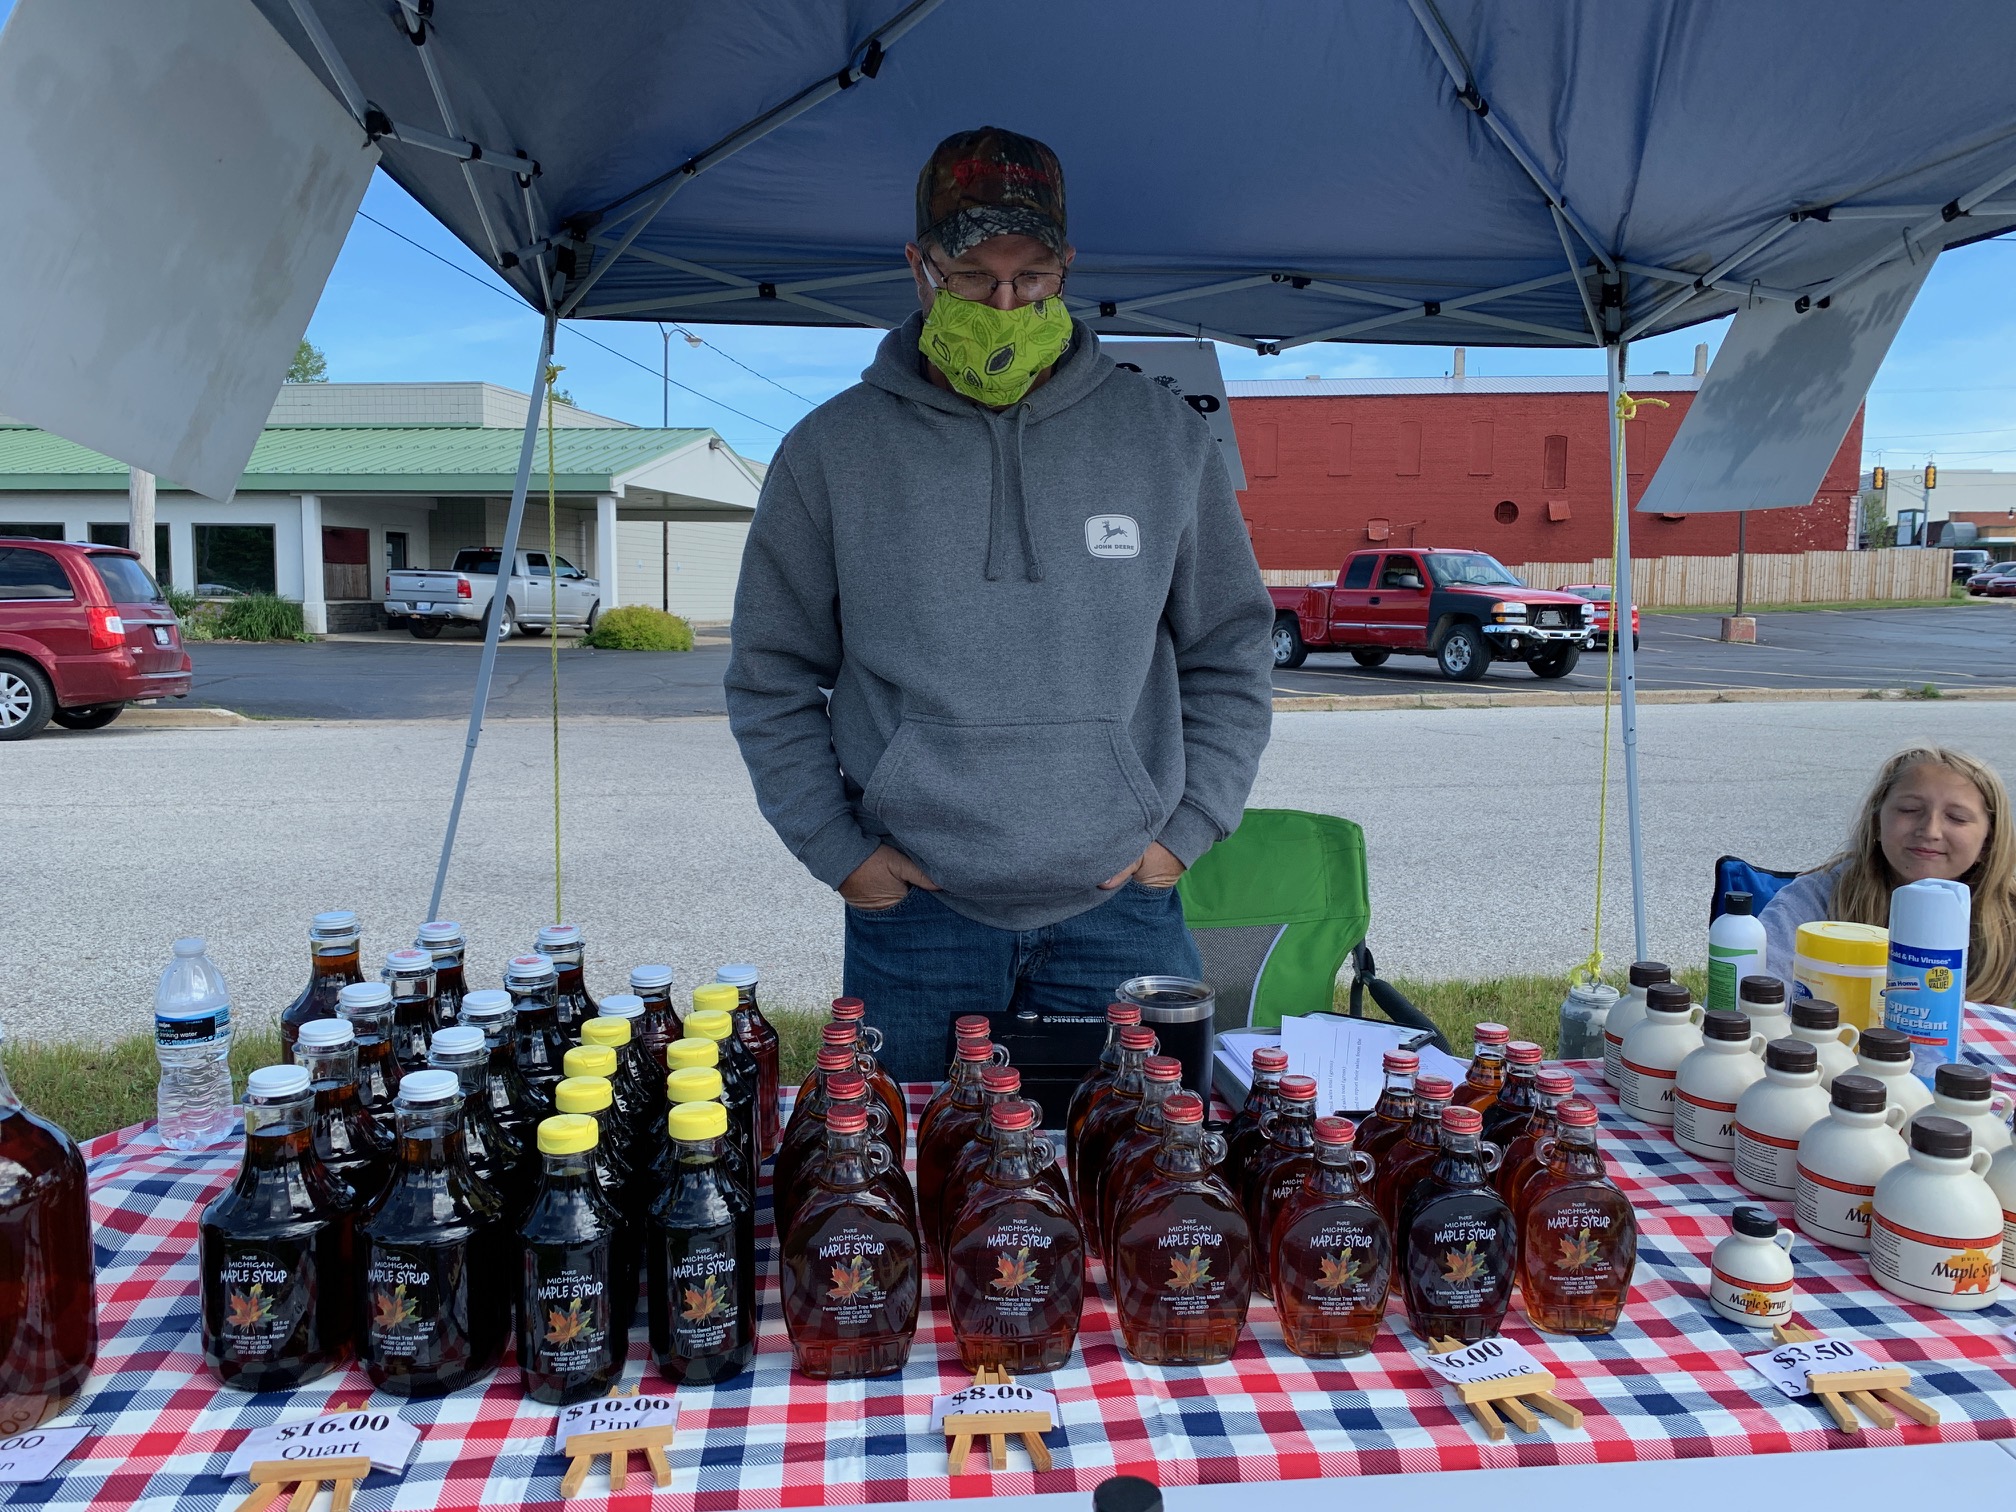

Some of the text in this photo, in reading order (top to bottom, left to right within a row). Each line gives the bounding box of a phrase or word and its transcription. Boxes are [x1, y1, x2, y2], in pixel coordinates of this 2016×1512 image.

[998, 1225, 1041, 1233] MICHIGAN
[1169, 1225, 1211, 1233] MICHIGAN
[1548, 1215, 1610, 1230] MAPLE SYRUP
[829, 1234, 873, 1242] MICHIGAN
[987, 1234, 1051, 1248] MAPLE SYRUP
[1159, 1233, 1222, 1249] MAPLE SYRUP
[1310, 1235, 1372, 1249] MAPLE SYRUP
[1435, 1228, 1496, 1244] MAPLE SYRUP
[682, 1252, 725, 1263] MICHIGAN
[820, 1242, 884, 1259] MAPLE SYRUP
[375, 1262, 416, 1270] MICHIGAN
[673, 1258, 735, 1280] MAPLE SYRUP
[1931, 1262, 1980, 1283] Maple
[220, 1269, 287, 1283] MAPLE SYRUP
[368, 1270, 430, 1285] MAPLE SYRUP
[547, 1275, 592, 1284] MICHIGAN
[538, 1282, 603, 1300] MAPLE SYRUP
[1729, 1293, 1786, 1312] Maple Syrup
[1428, 1341, 1503, 1368] $6.00
[1773, 1341, 1854, 1370] $3.50
[952, 1386, 1032, 1406] $8.00
[566, 1398, 670, 1422] $10.00
[276, 1414, 390, 1441] $16.00
[589, 1418, 638, 1431] Pint
[282, 1441, 362, 1460] Quart
